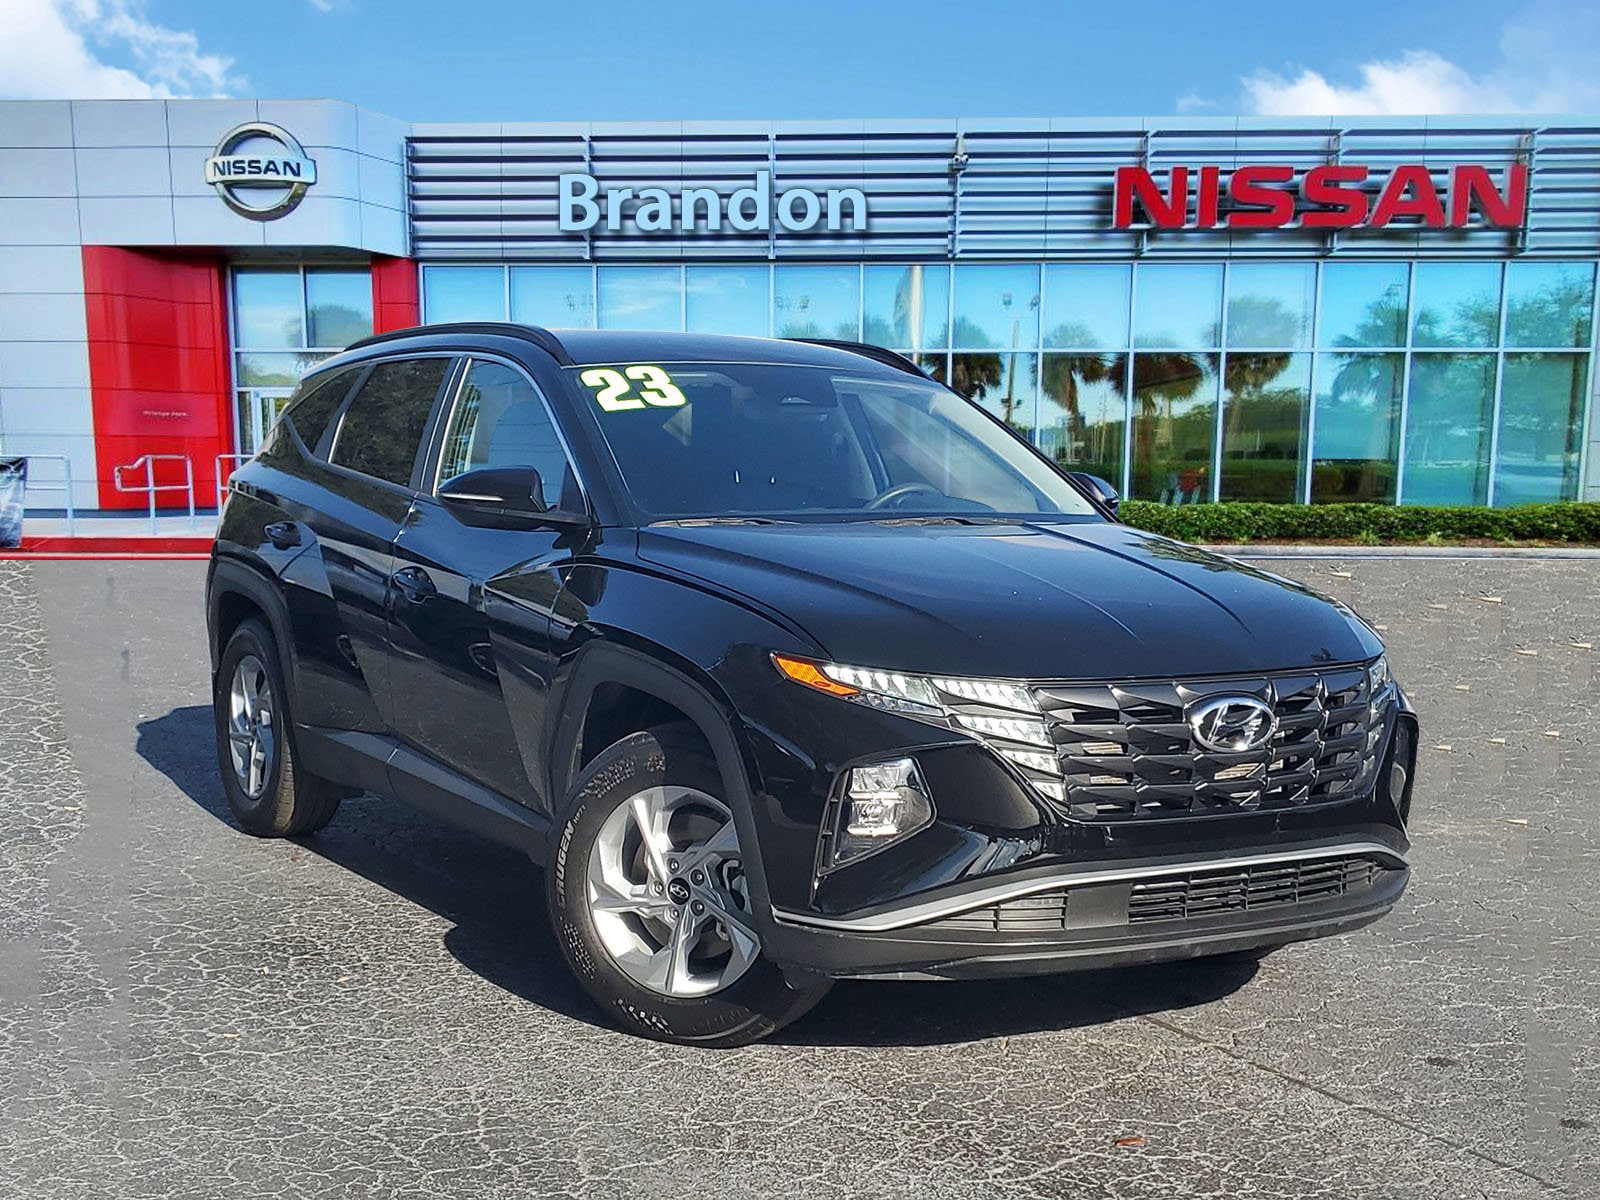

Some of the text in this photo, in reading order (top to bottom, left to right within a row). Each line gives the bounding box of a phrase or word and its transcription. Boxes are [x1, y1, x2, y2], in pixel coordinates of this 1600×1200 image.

[213, 160, 301, 177] NISSAN
[558, 170, 868, 232] Brandon
[1113, 165, 1529, 229] NISSAN
[580, 364, 687, 413] 23
